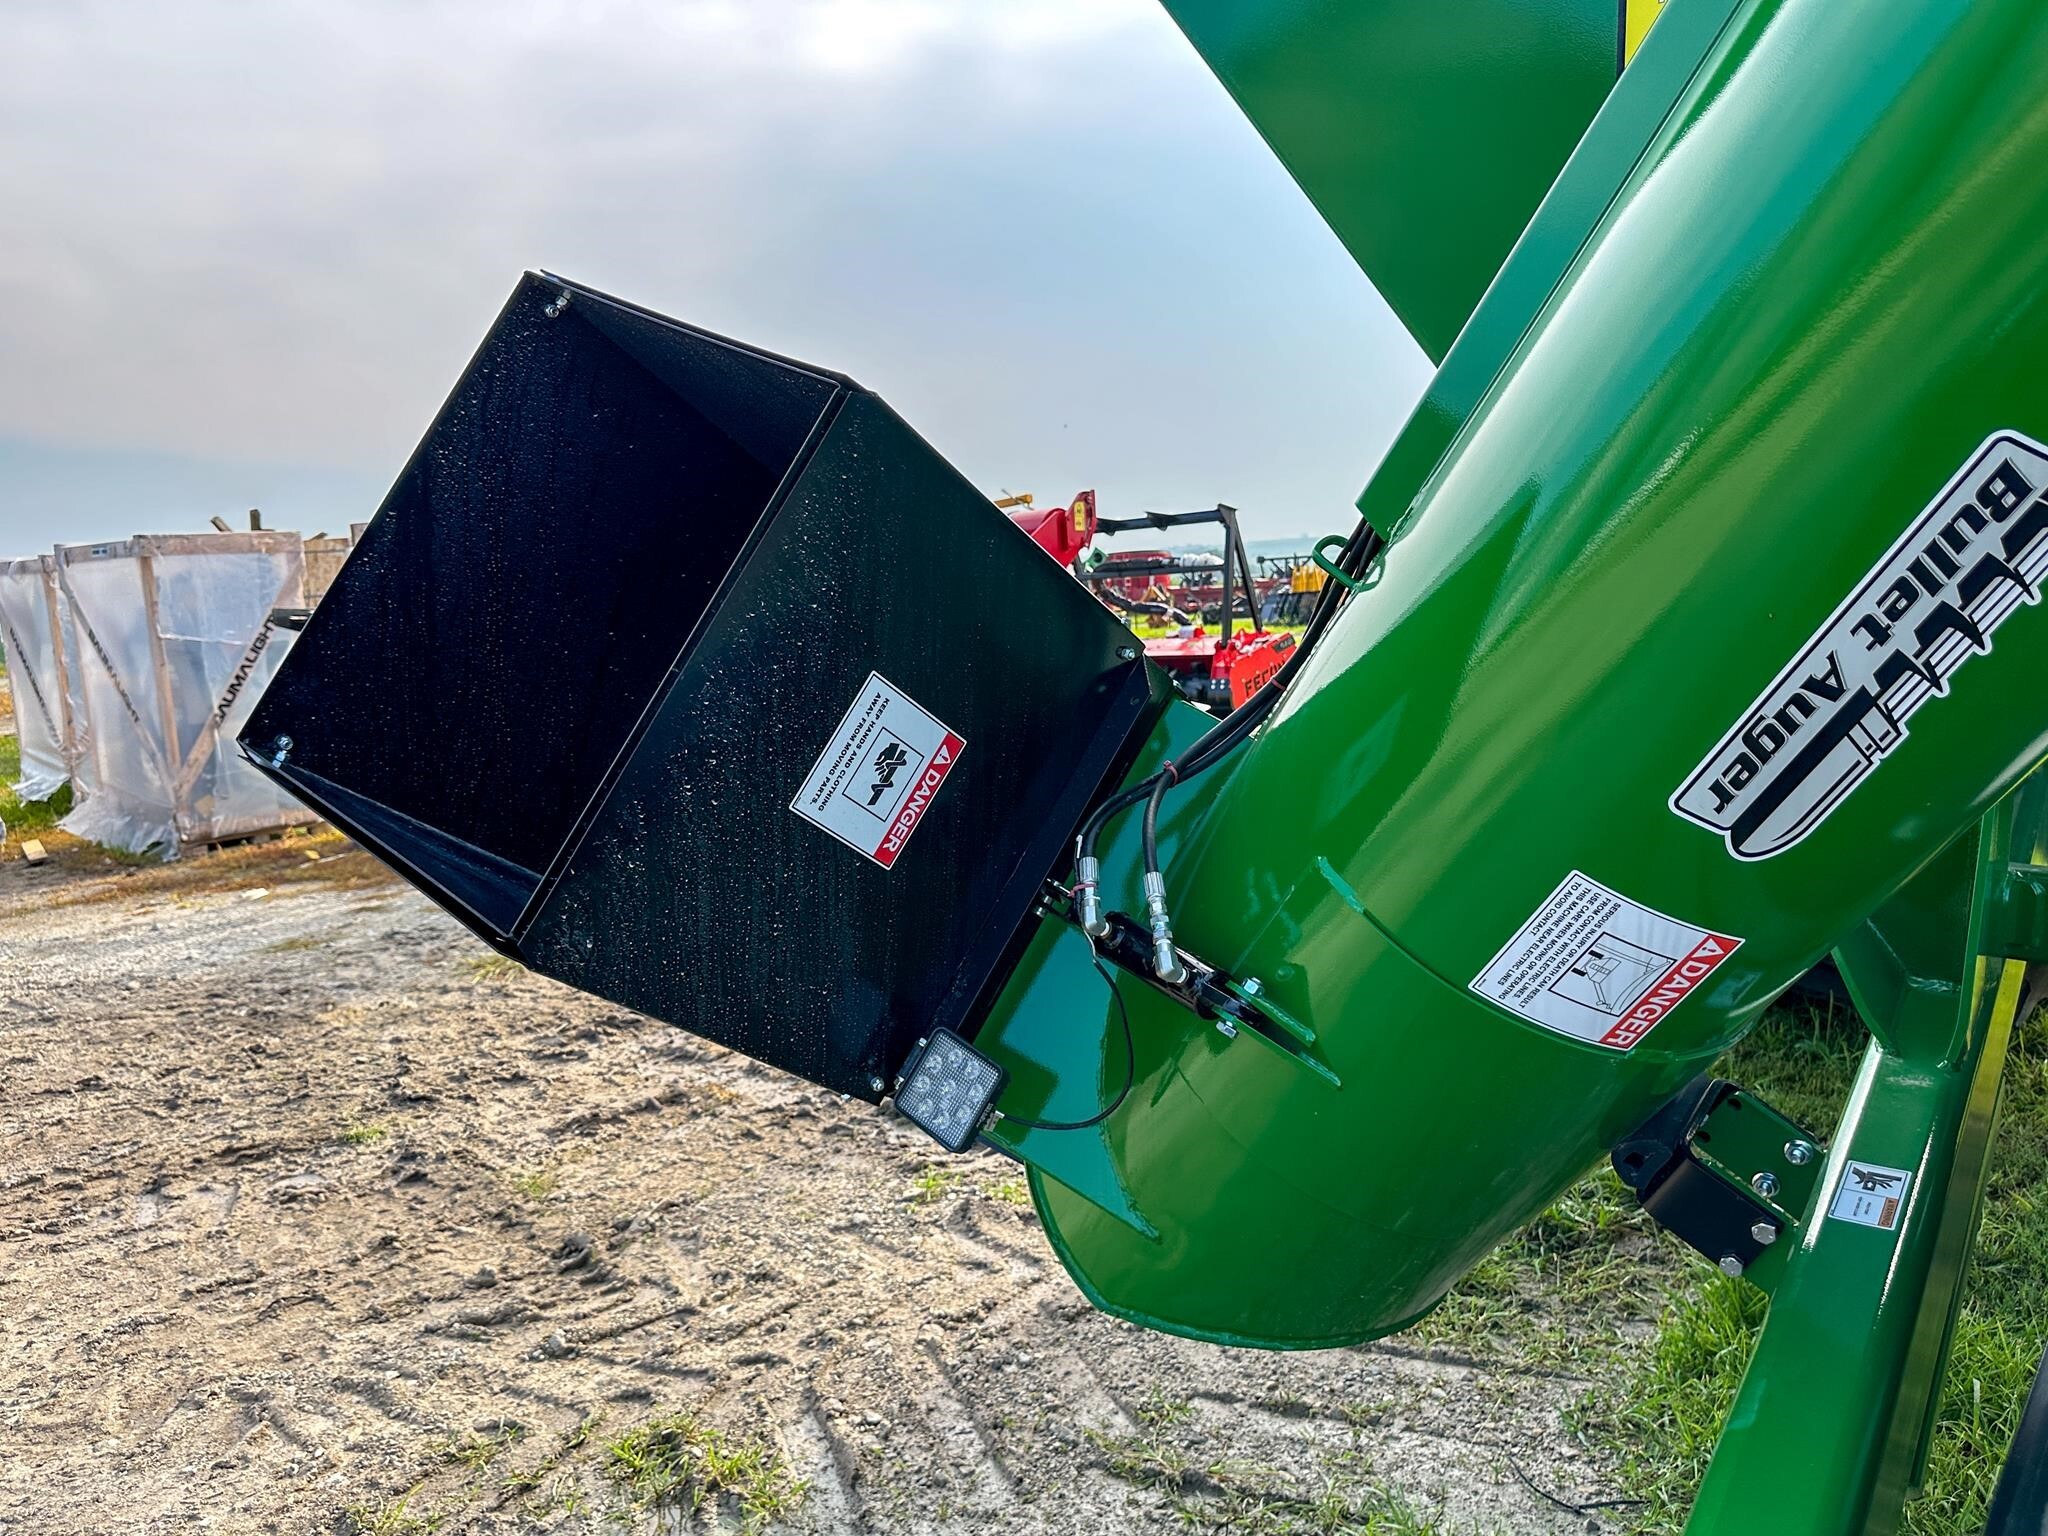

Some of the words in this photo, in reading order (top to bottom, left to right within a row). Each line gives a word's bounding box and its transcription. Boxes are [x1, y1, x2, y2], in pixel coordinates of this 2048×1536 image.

[1850, 457, 2035, 652] Bullet
[865, 691, 882, 718] AWAY
[875, 697, 890, 721] KEEP
[849, 717, 867, 742] FROM
[855, 720, 876, 750] HANDS
[1706, 650, 1849, 815] Auger
[828, 741, 852, 776] MOVING
[844, 750, 858, 769] AND
[809, 776, 831, 805] PARTS.
[817, 769, 846, 812] CLOTHING
[882, 768, 941, 852] DANGER
[1570, 881, 1583, 891] TO
[1575, 887, 1592, 902] THIS
[1554, 889, 1573, 909] AVOID
[1586, 892, 1602, 906] USE
[1591, 897, 1612, 916] FROM
[1528, 908, 1557, 937] CONTACT.
[1550, 900, 1579, 928] MACHINE
[1570, 905, 1590, 923] CARE
[1593, 902, 1622, 929] SERIOUS
[1535, 926, 1555, 944] NEAR
[1554, 921, 1575, 940] WHEN
[1567, 914, 1595, 943] CONTACT
[1575, 927, 1598, 950] INJURY
[1511, 942, 1540, 971] ELECTRIC
[1534, 938, 1559, 962] MOVING
[1552, 941, 1571, 958] WITH
[1565, 948, 1578, 959] OR
[1497, 969, 1516, 986] LINES
[1525, 960, 1538, 971] OR
[1528, 955, 1557, 983] ELECTRIC
[1548, 957, 1570, 977] DEATH
[1498, 969, 1529, 1000] OPERATING
[1511, 981, 1532, 999] LINES.
[1537, 975, 1552, 989] CAN
[1518, 987, 1541, 1009] RESULT
[1606, 960, 1710, 1045] DANGER
